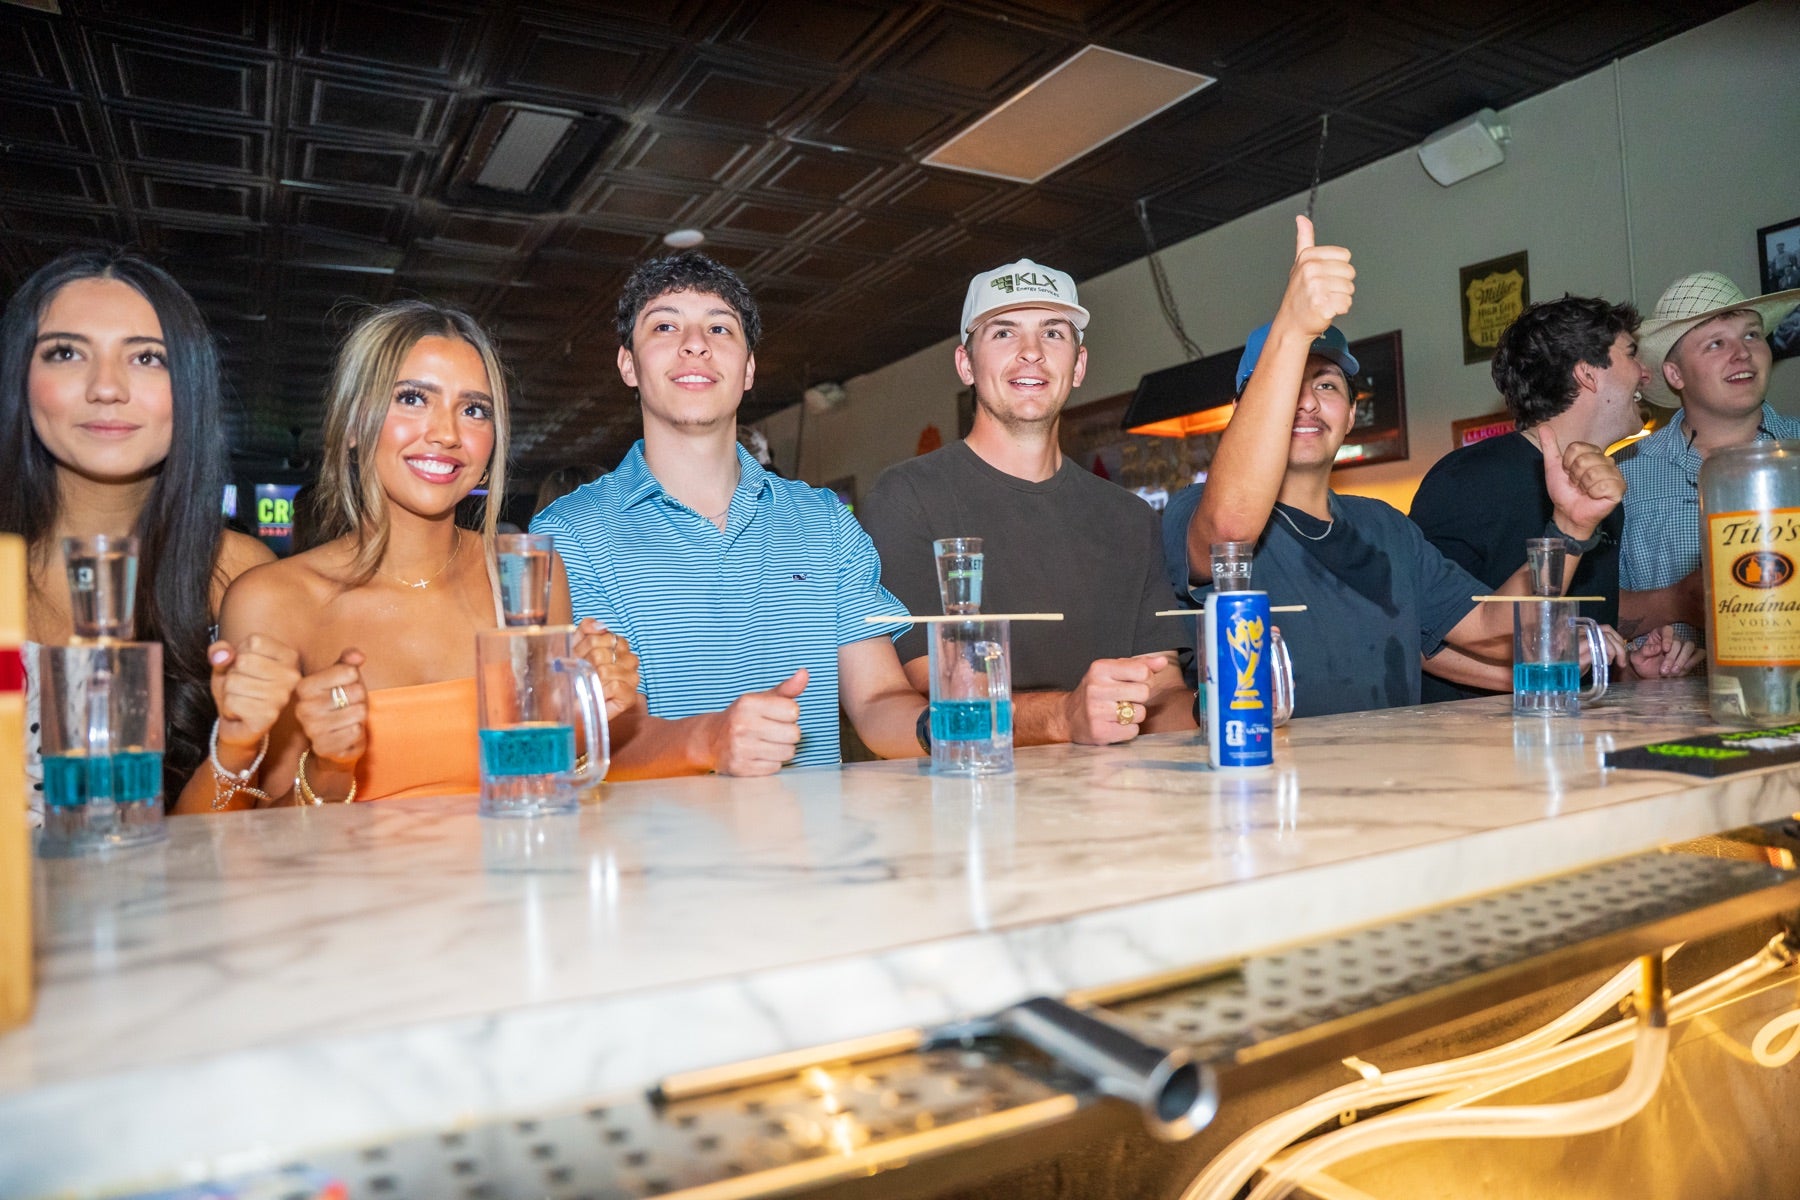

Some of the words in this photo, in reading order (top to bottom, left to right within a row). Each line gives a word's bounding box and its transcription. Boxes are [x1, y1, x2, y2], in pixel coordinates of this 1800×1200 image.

[1015, 272, 1058, 291] KLX
[1038, 286, 1060, 297] Services
[1474, 280, 1516, 305] Miller
[1722, 518, 1800, 546] Tito's
[1739, 618, 1792, 628] VODKA
